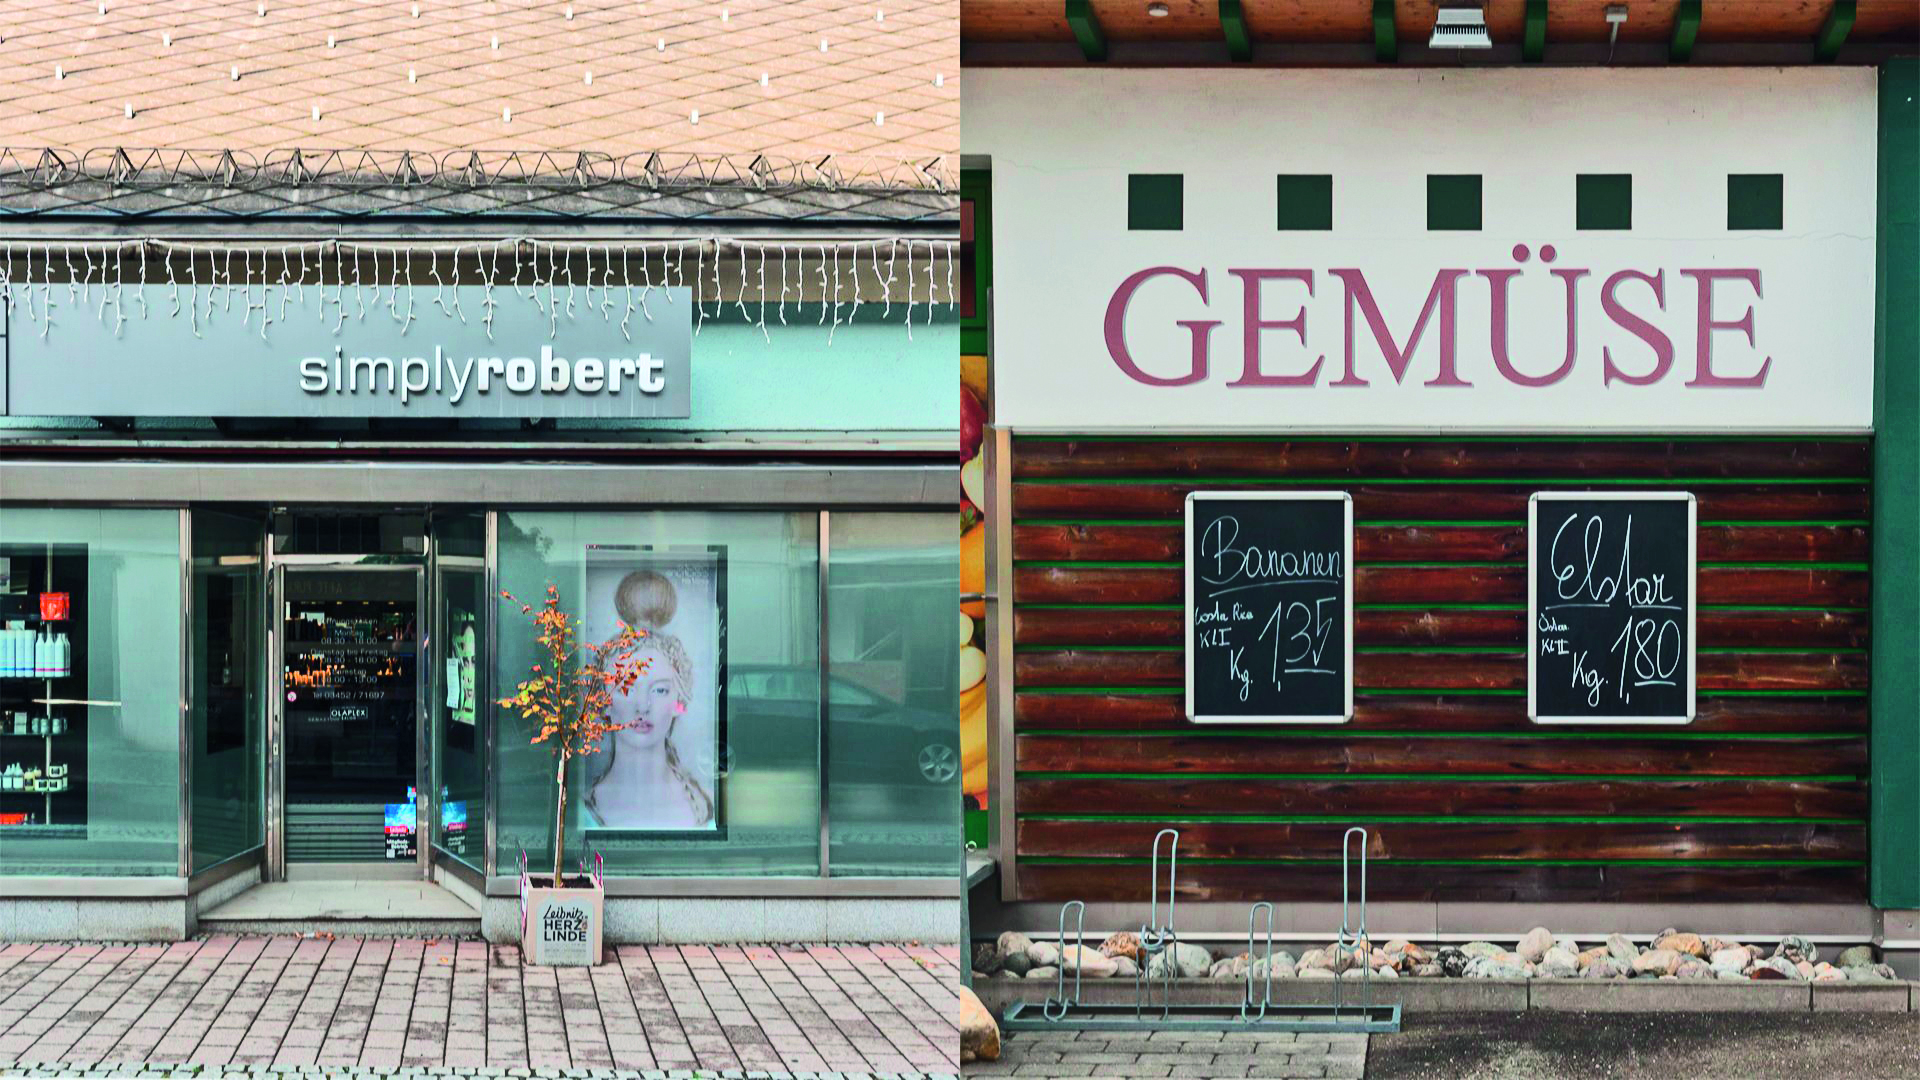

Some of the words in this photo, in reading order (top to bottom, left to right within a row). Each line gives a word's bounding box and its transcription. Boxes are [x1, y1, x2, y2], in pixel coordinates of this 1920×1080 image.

[1103, 243, 1772, 389] GEMÜSE
[1201, 515, 1343, 590] Bananen
[1551, 513, 1673, 606] Elstar
[1195, 600, 1229, 626] Costa
[1233, 601, 1254, 621] Rica
[331, 709, 366, 717] OLAPLEX
[544, 919, 582, 930] HERZ
[544, 930, 587, 941] LINDE
